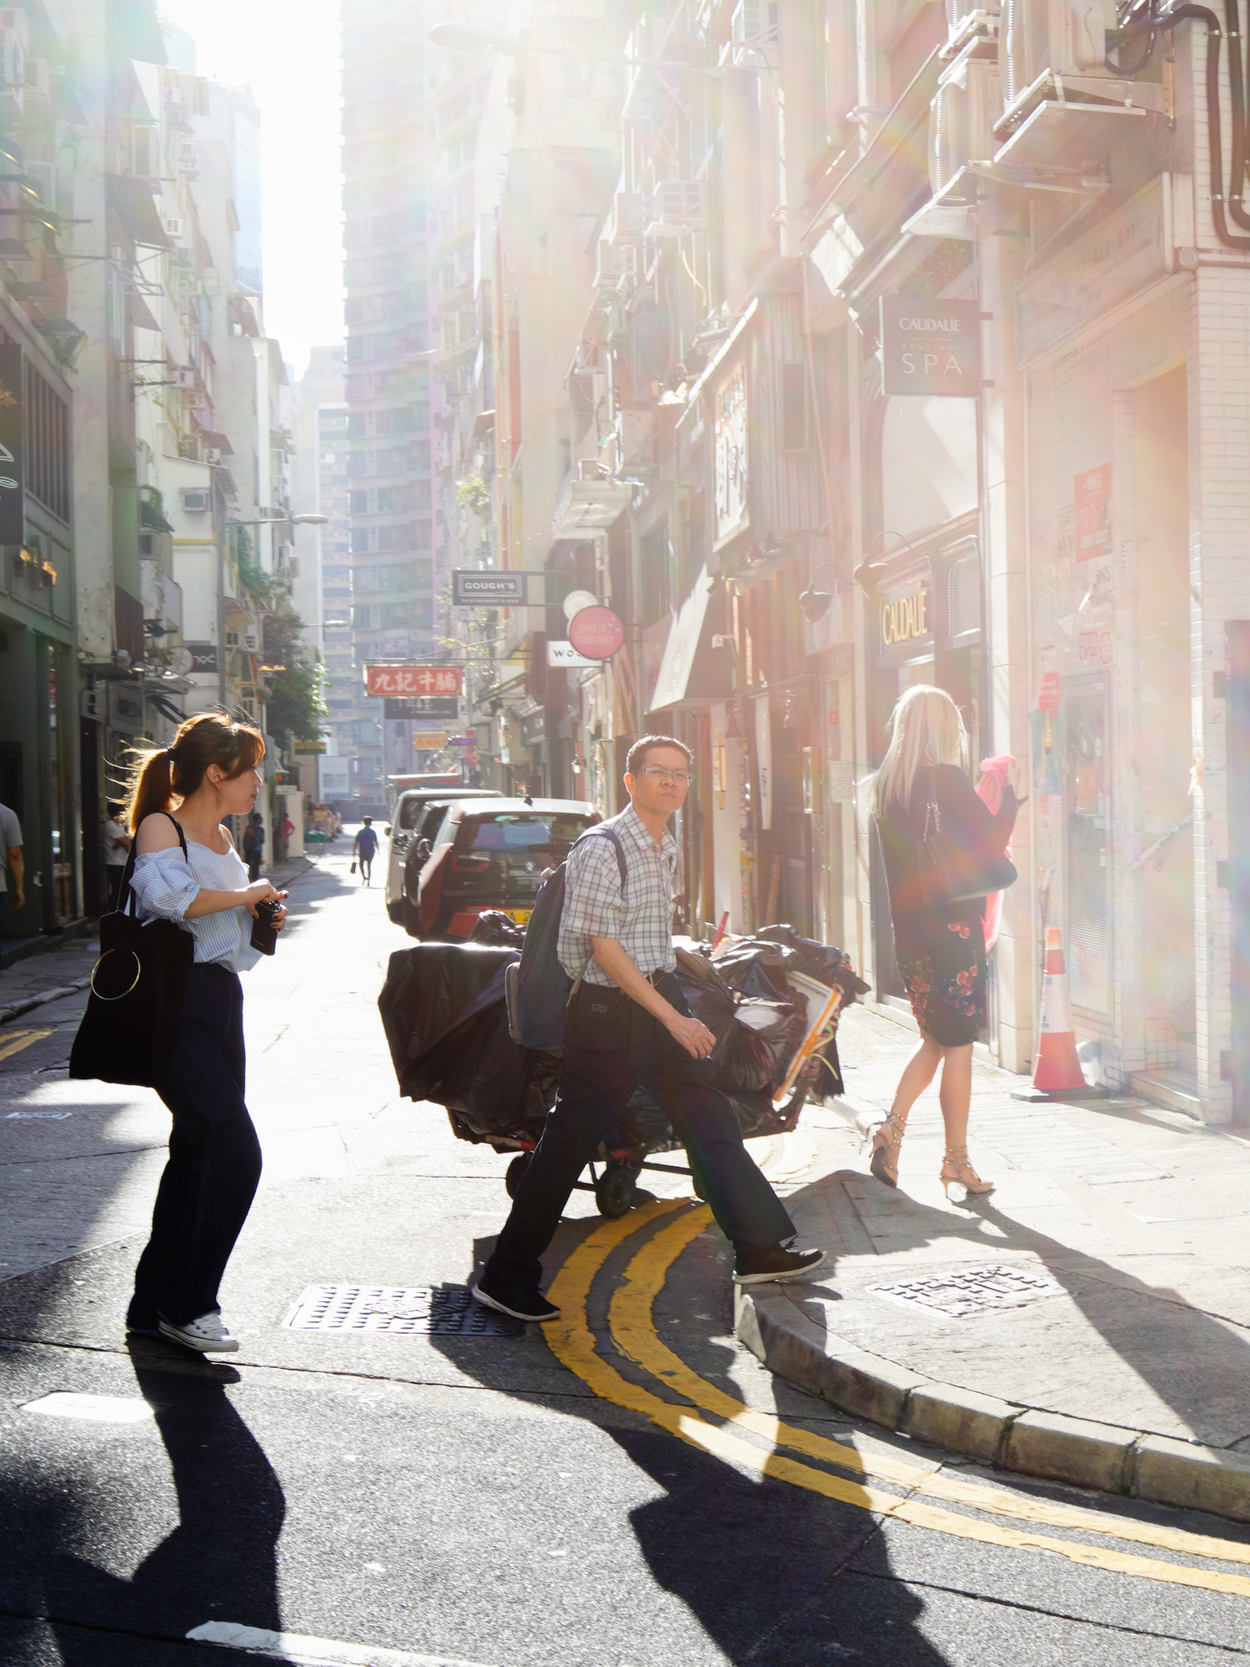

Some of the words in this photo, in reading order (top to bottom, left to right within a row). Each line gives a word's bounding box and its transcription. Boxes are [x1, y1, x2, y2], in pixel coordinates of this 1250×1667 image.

[902, 353, 963, 376] SPA
[464, 581, 516, 590] GOUGH'S
[578, 623, 607, 636] petit
